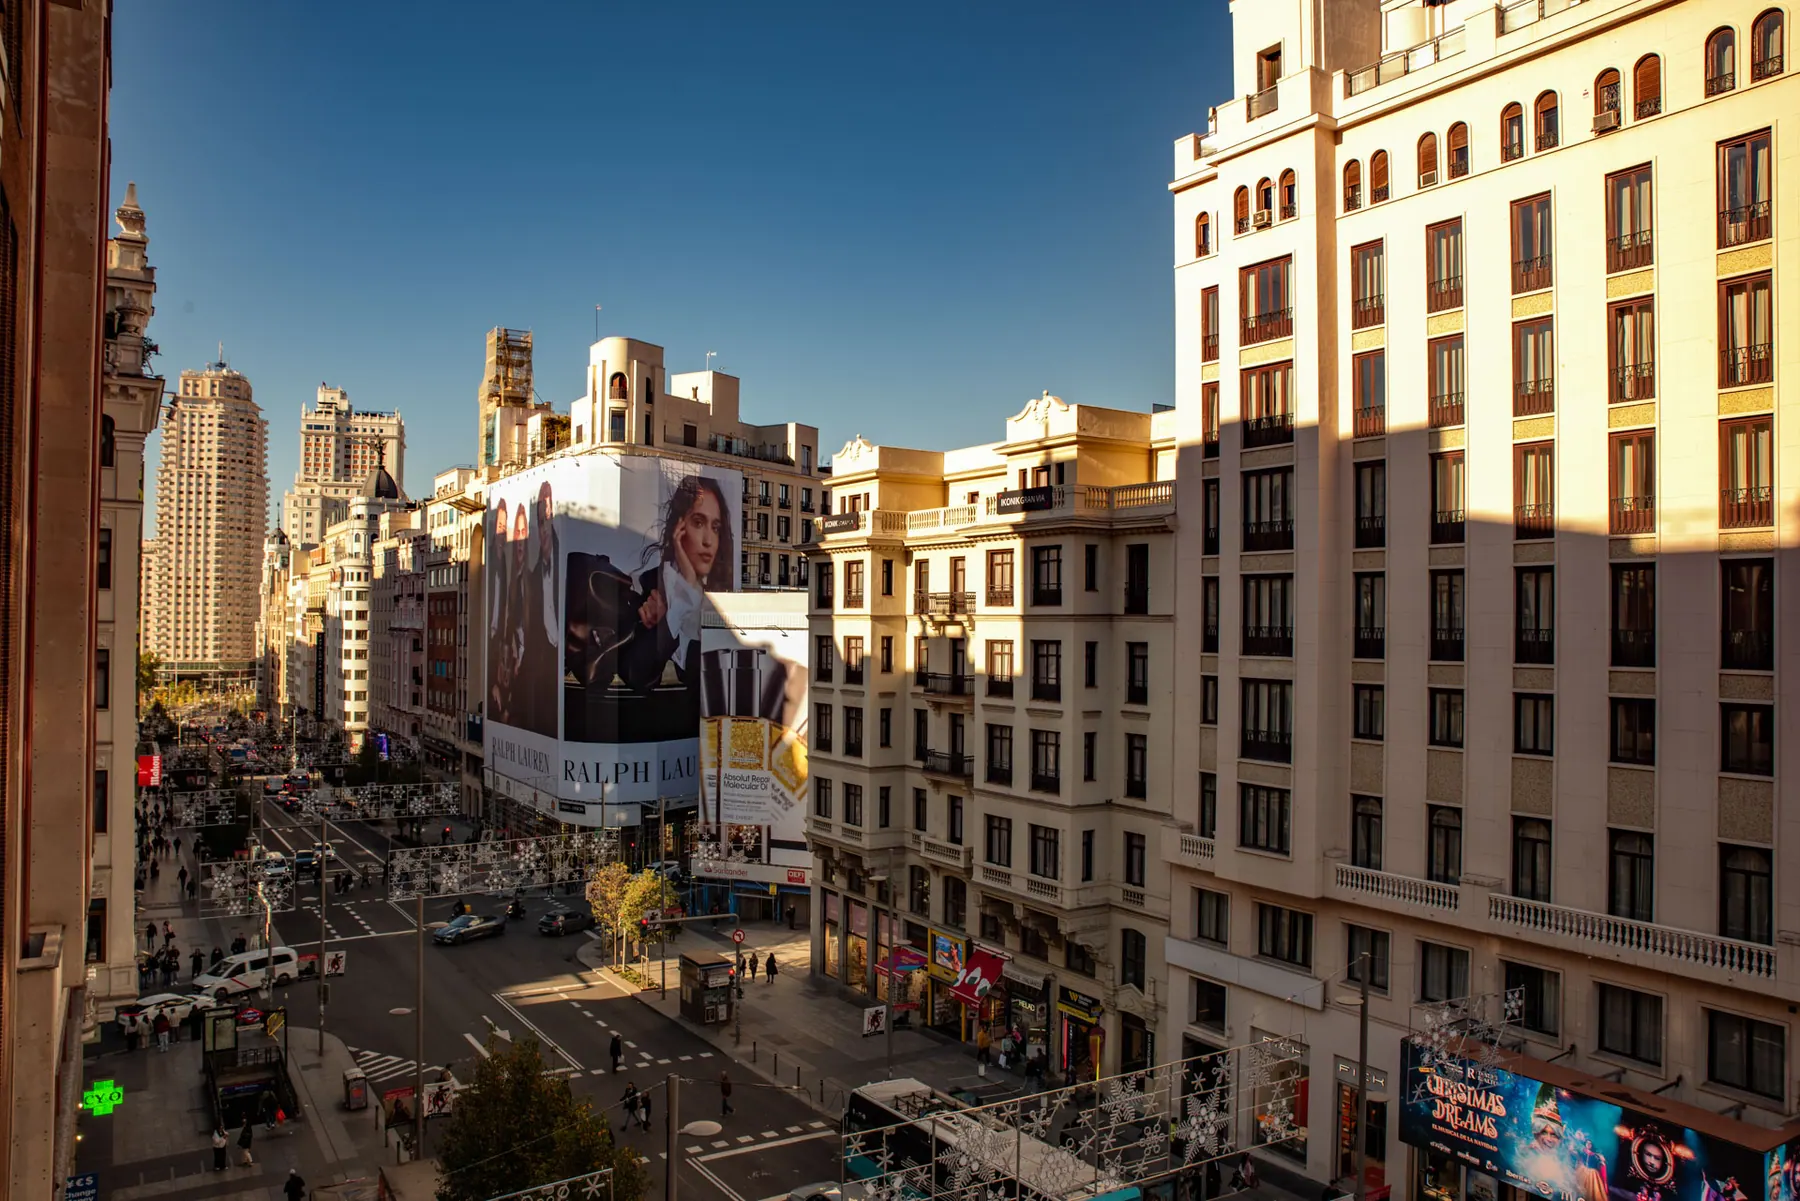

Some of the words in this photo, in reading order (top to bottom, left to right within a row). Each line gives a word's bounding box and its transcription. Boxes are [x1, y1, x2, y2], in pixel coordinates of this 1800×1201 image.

[1001, 496, 1020, 507] IKONIK
[492, 736, 516, 762] RALPH
[518, 747, 550, 775] LAUREN
[564, 759, 650, 784] RALPH
[723, 772, 750, 783] Absolut
[723, 780, 760, 790] Molecular
[713, 866, 748, 876] Santander
[1425, 1073, 1507, 1117] CHRISTMAS
[1431, 1098, 1499, 1139] DREAMS
[1474, 1138, 1499, 1153] NAVIDAD
